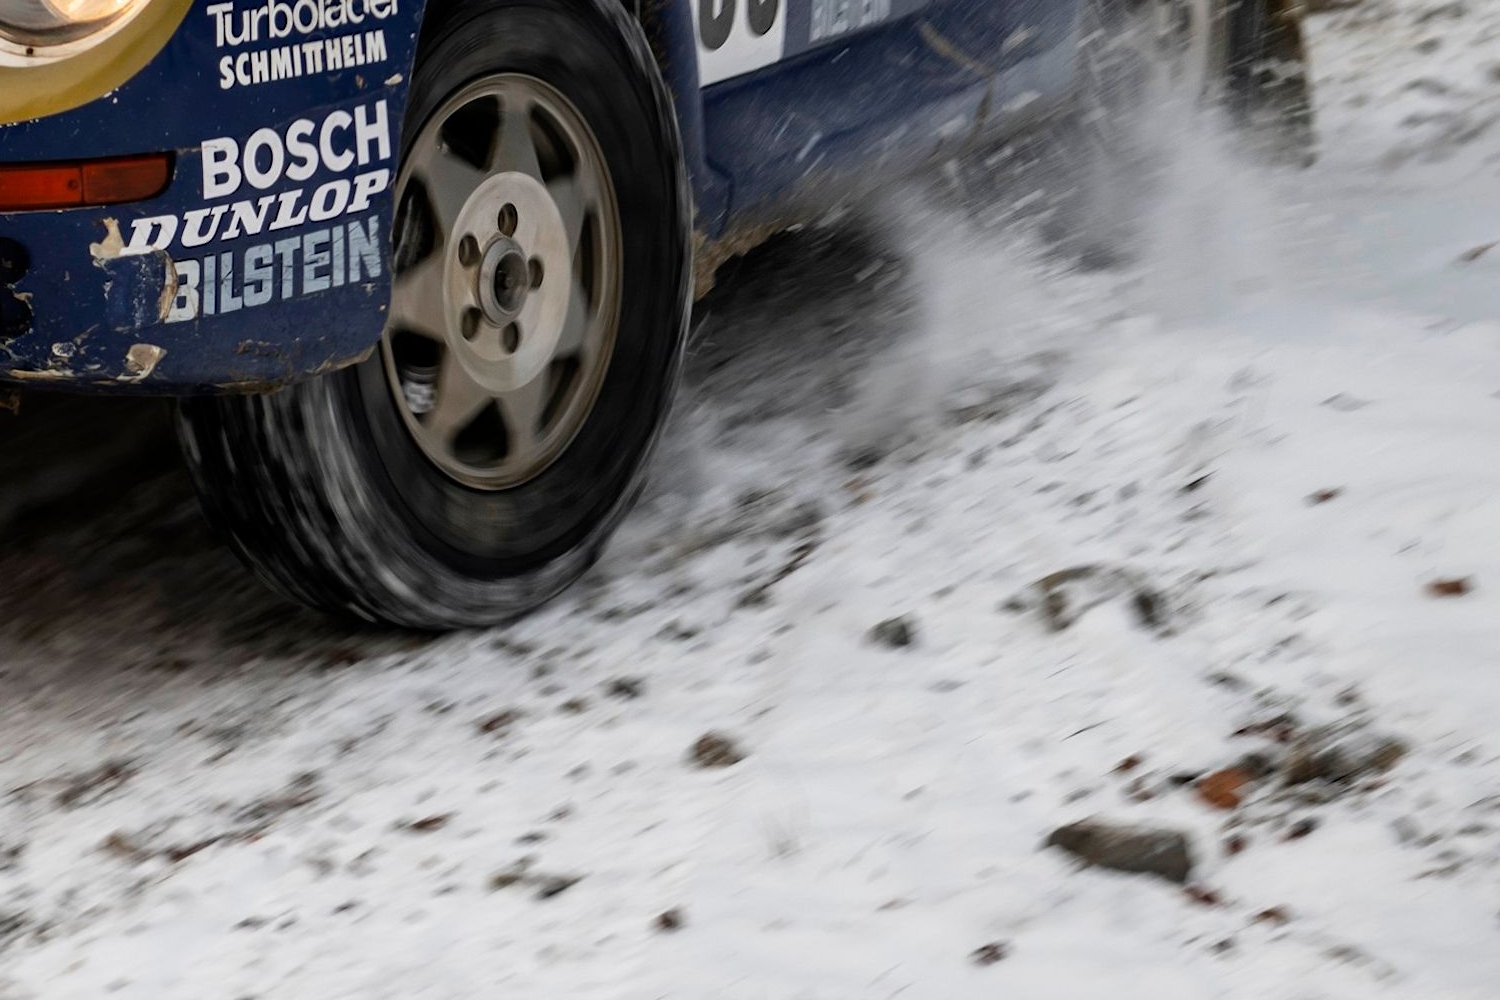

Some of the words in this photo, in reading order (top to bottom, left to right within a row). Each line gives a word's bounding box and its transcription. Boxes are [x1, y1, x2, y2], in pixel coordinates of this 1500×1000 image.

[201, 99, 392, 200] BOSCH
[119, 168, 391, 256] DUNLOP
[163, 215, 382, 325] BILSTEIN
